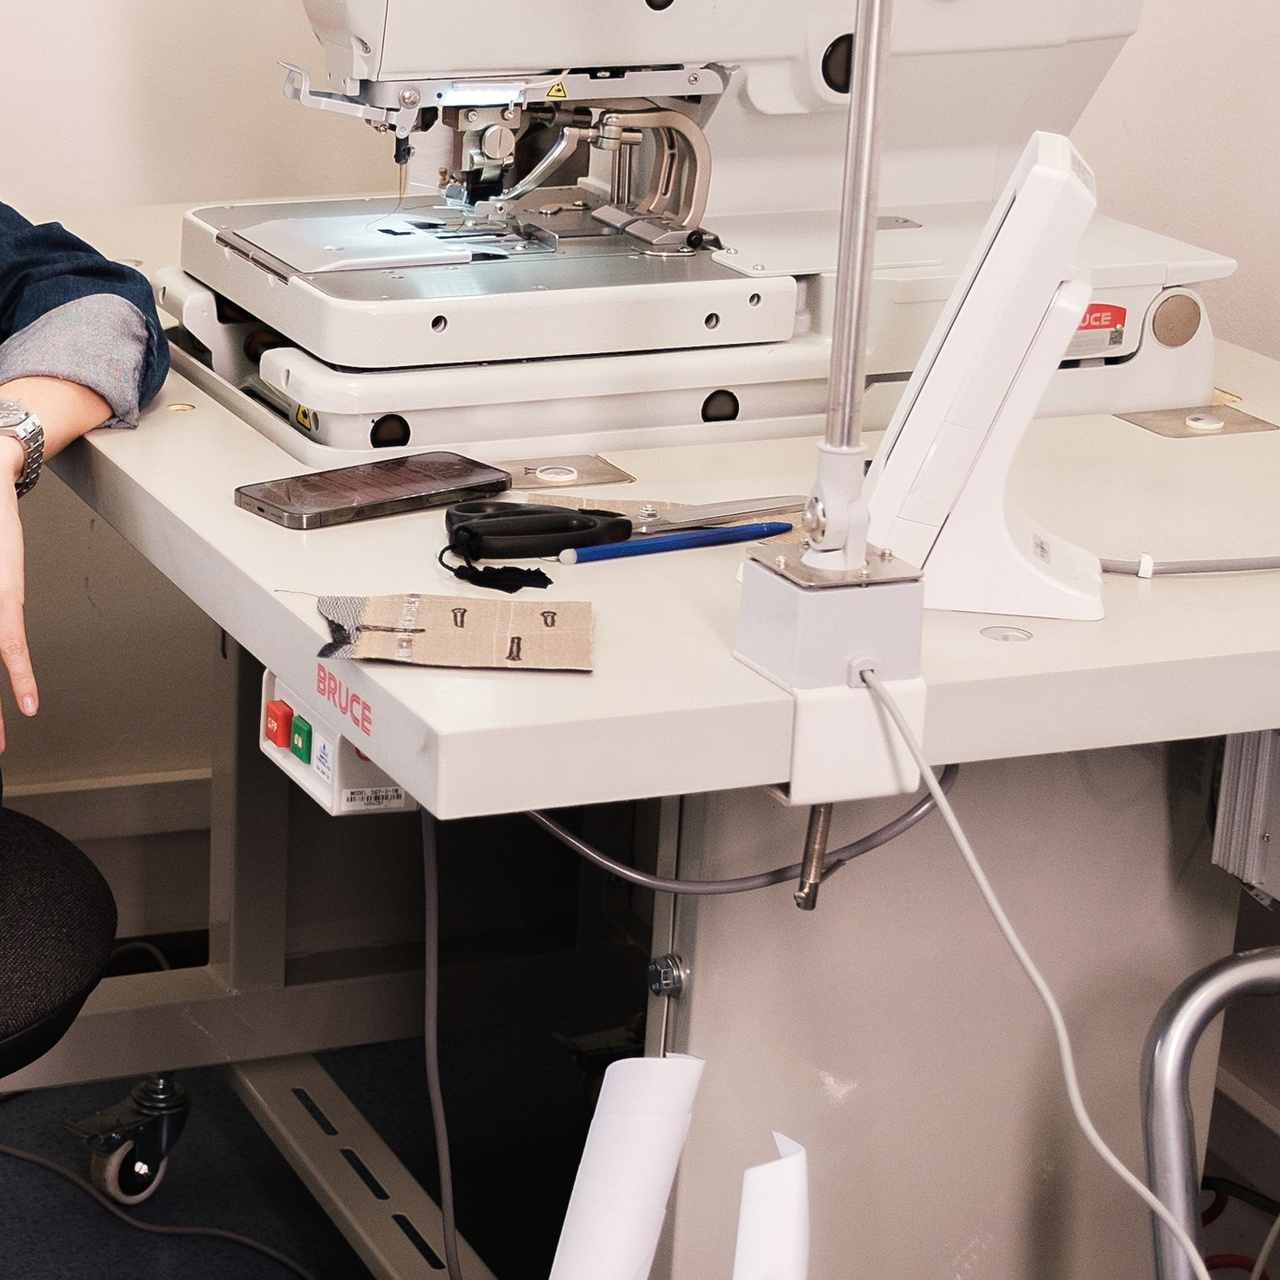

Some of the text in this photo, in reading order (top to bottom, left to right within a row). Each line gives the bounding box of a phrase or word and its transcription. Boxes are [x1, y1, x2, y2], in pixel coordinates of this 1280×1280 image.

[1080, 312, 1112, 326] UCE
[316, 662, 373, 737] BRUCE
[294, 733, 302, 748] ON
